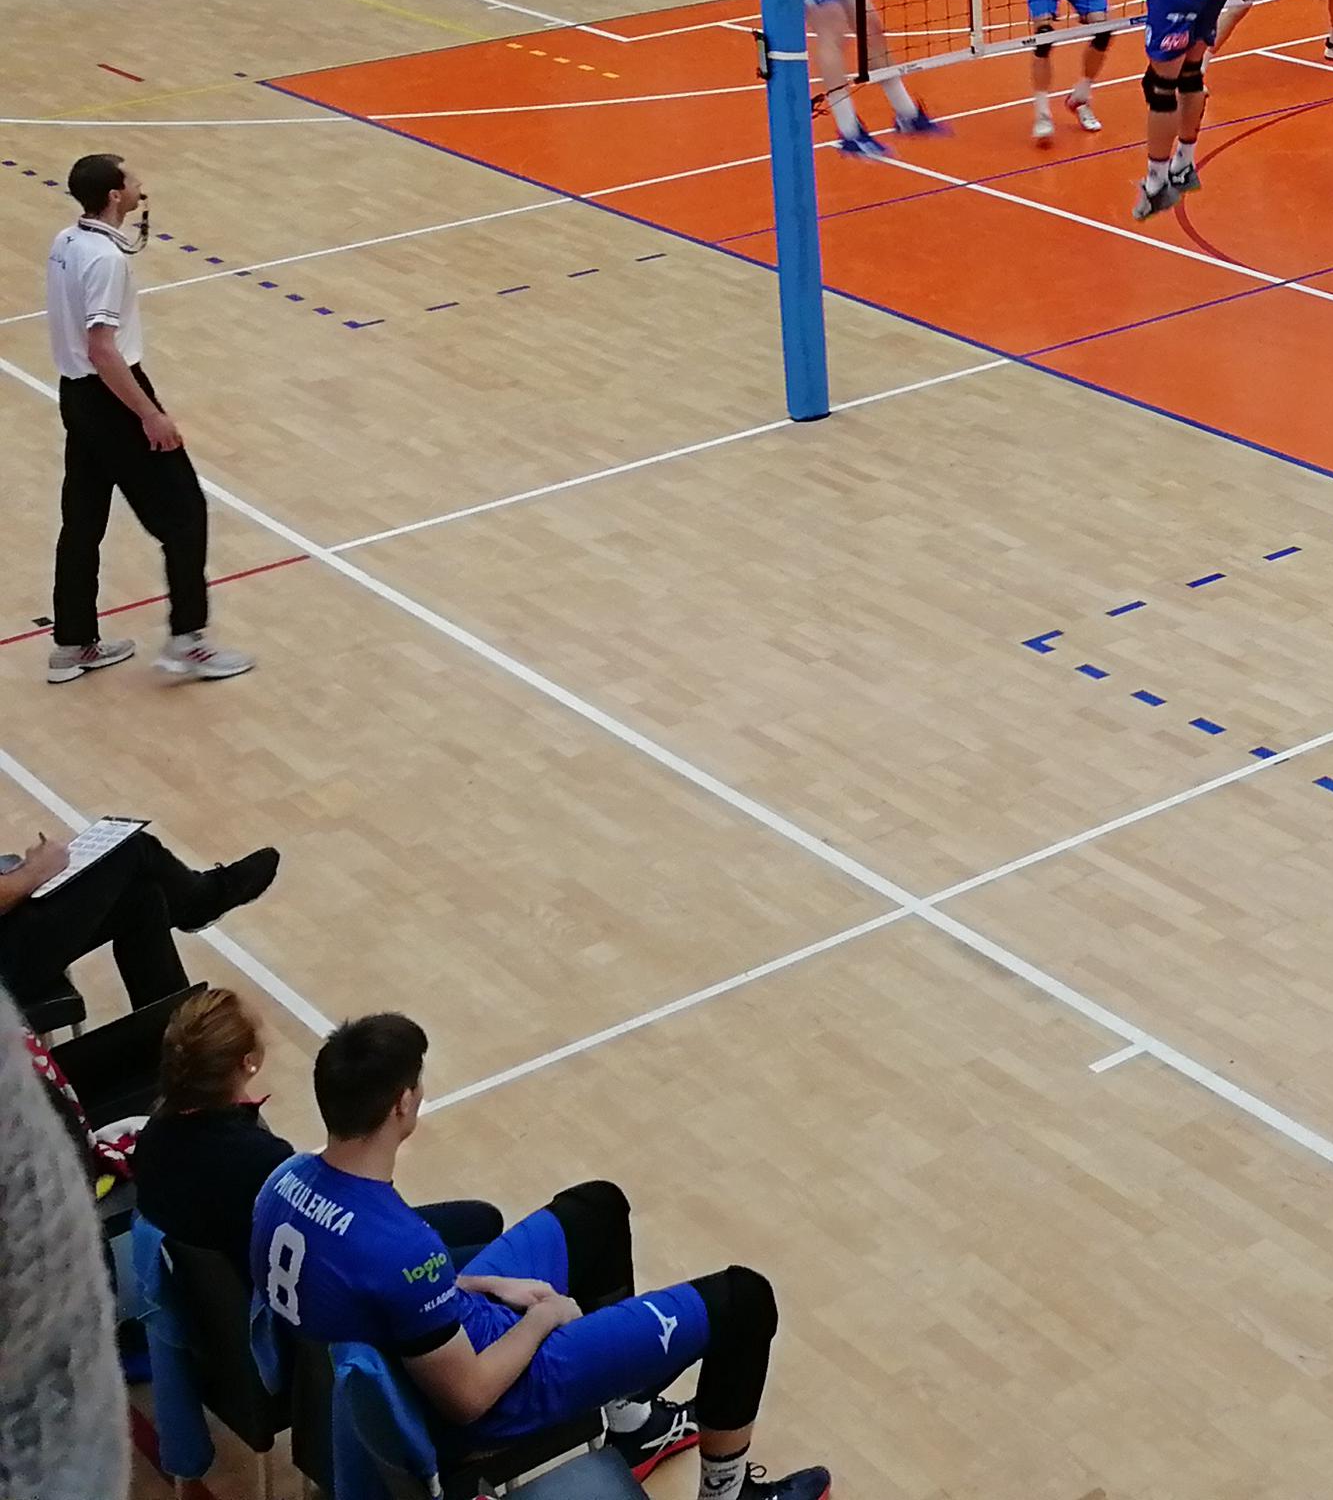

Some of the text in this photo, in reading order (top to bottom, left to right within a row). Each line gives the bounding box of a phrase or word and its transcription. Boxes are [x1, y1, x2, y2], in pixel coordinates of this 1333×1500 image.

[273, 1170, 355, 1236] MIKULENKA
[267, 1222, 306, 1326] 8
[402, 1251, 447, 1284] logio
